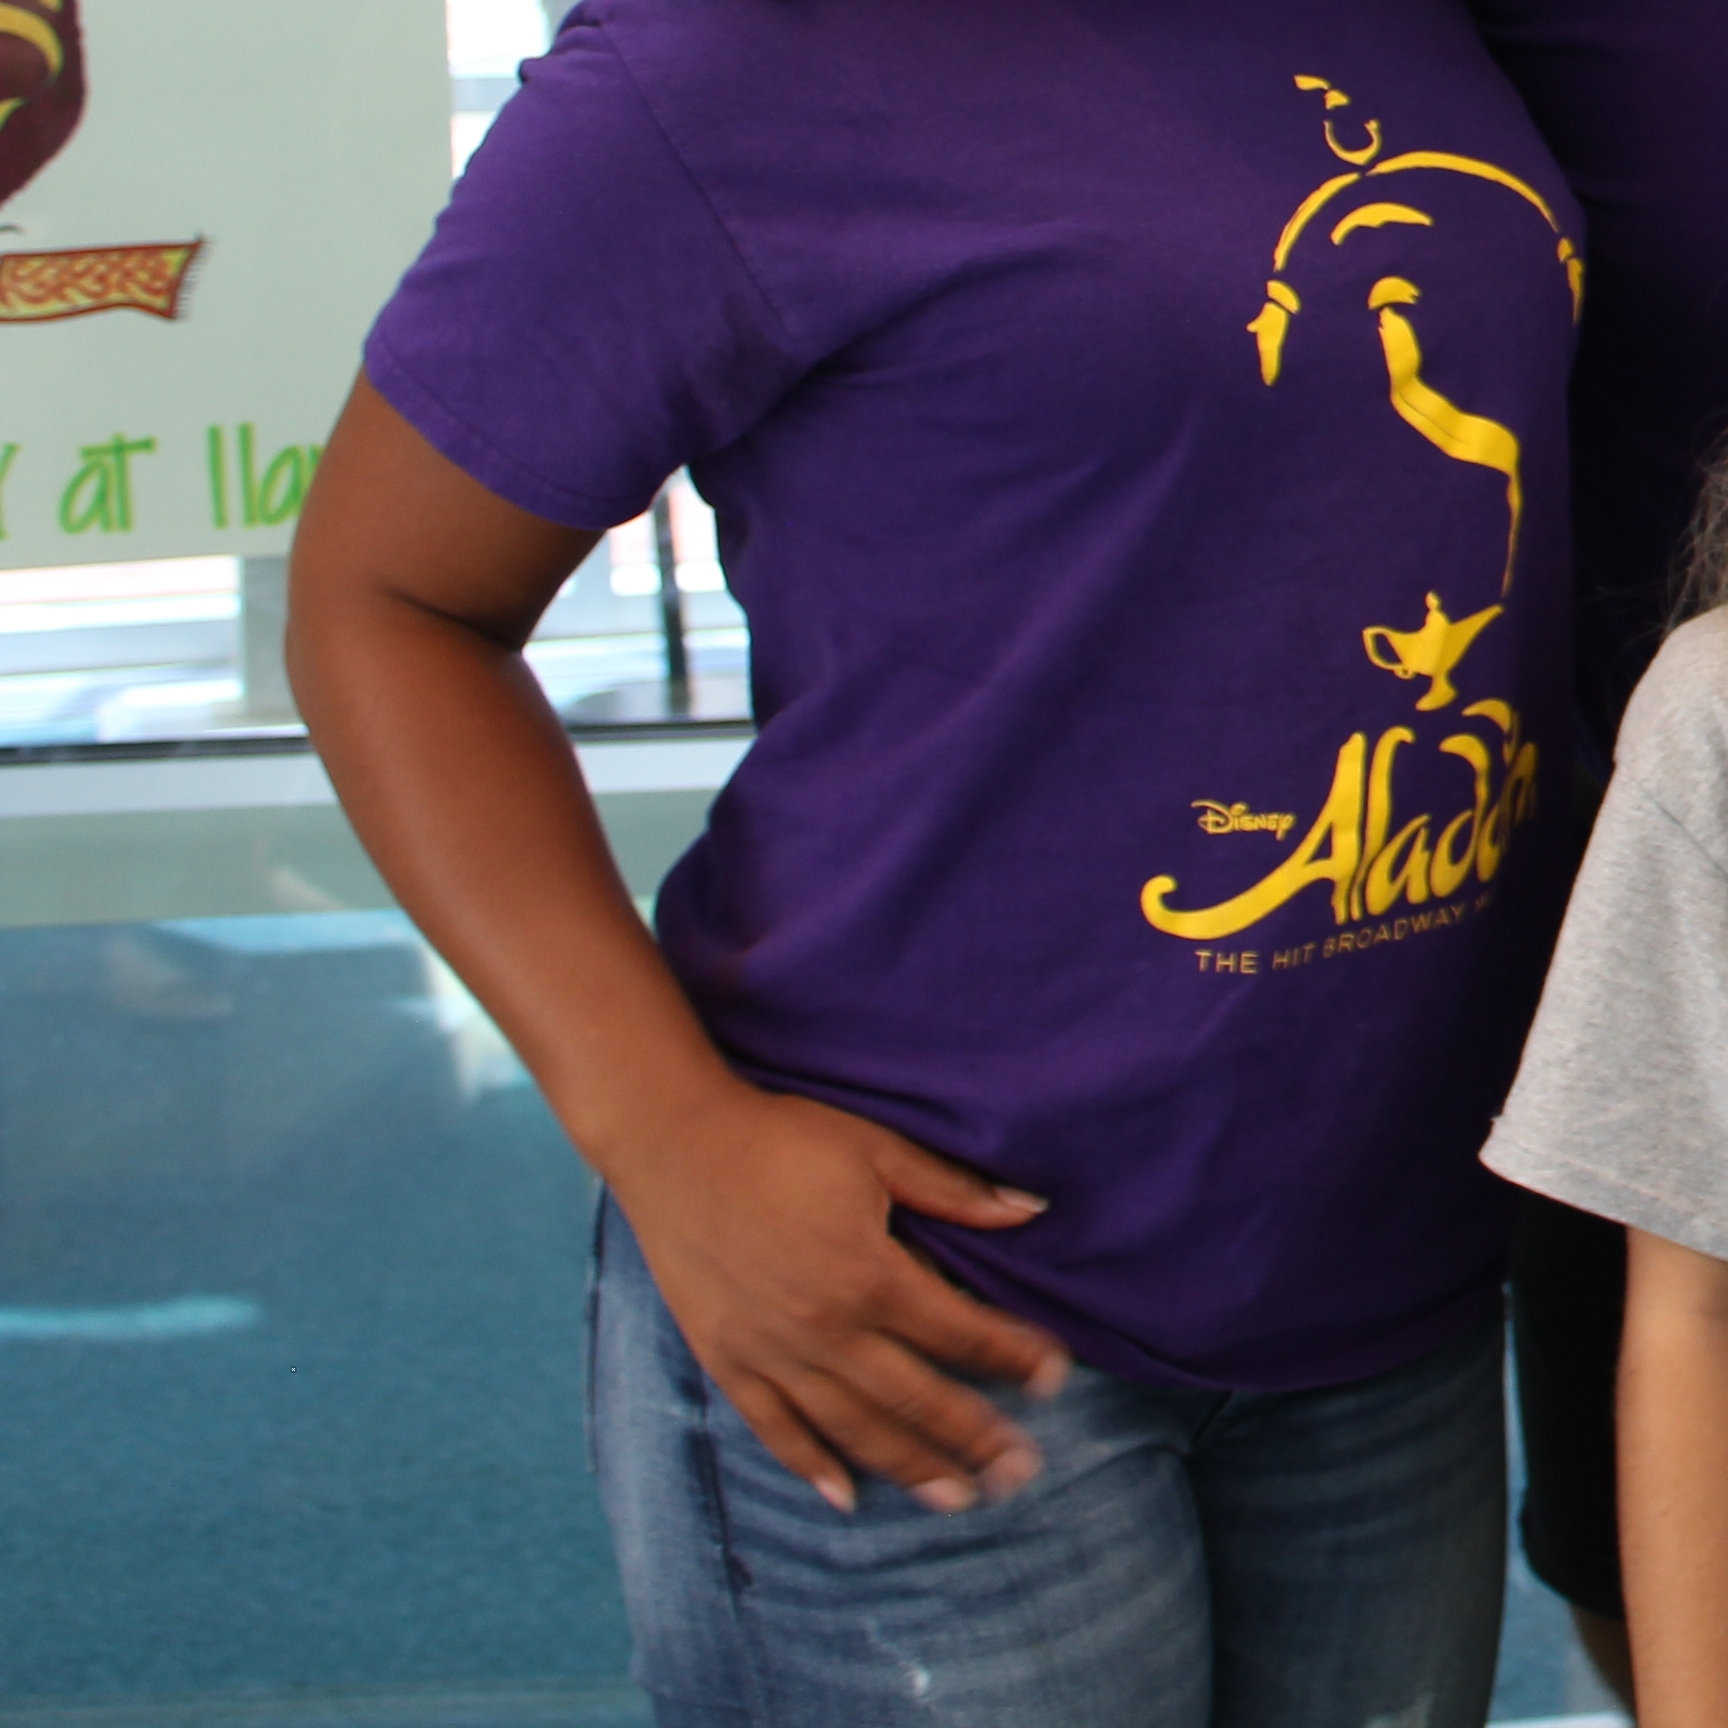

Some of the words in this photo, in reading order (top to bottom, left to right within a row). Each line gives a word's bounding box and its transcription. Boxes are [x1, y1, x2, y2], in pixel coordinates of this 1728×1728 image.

[1195, 949, 1259, 974] THE
[1272, 941, 1317, 970] HIT
[1322, 904, 1466, 959] BROADWAY
